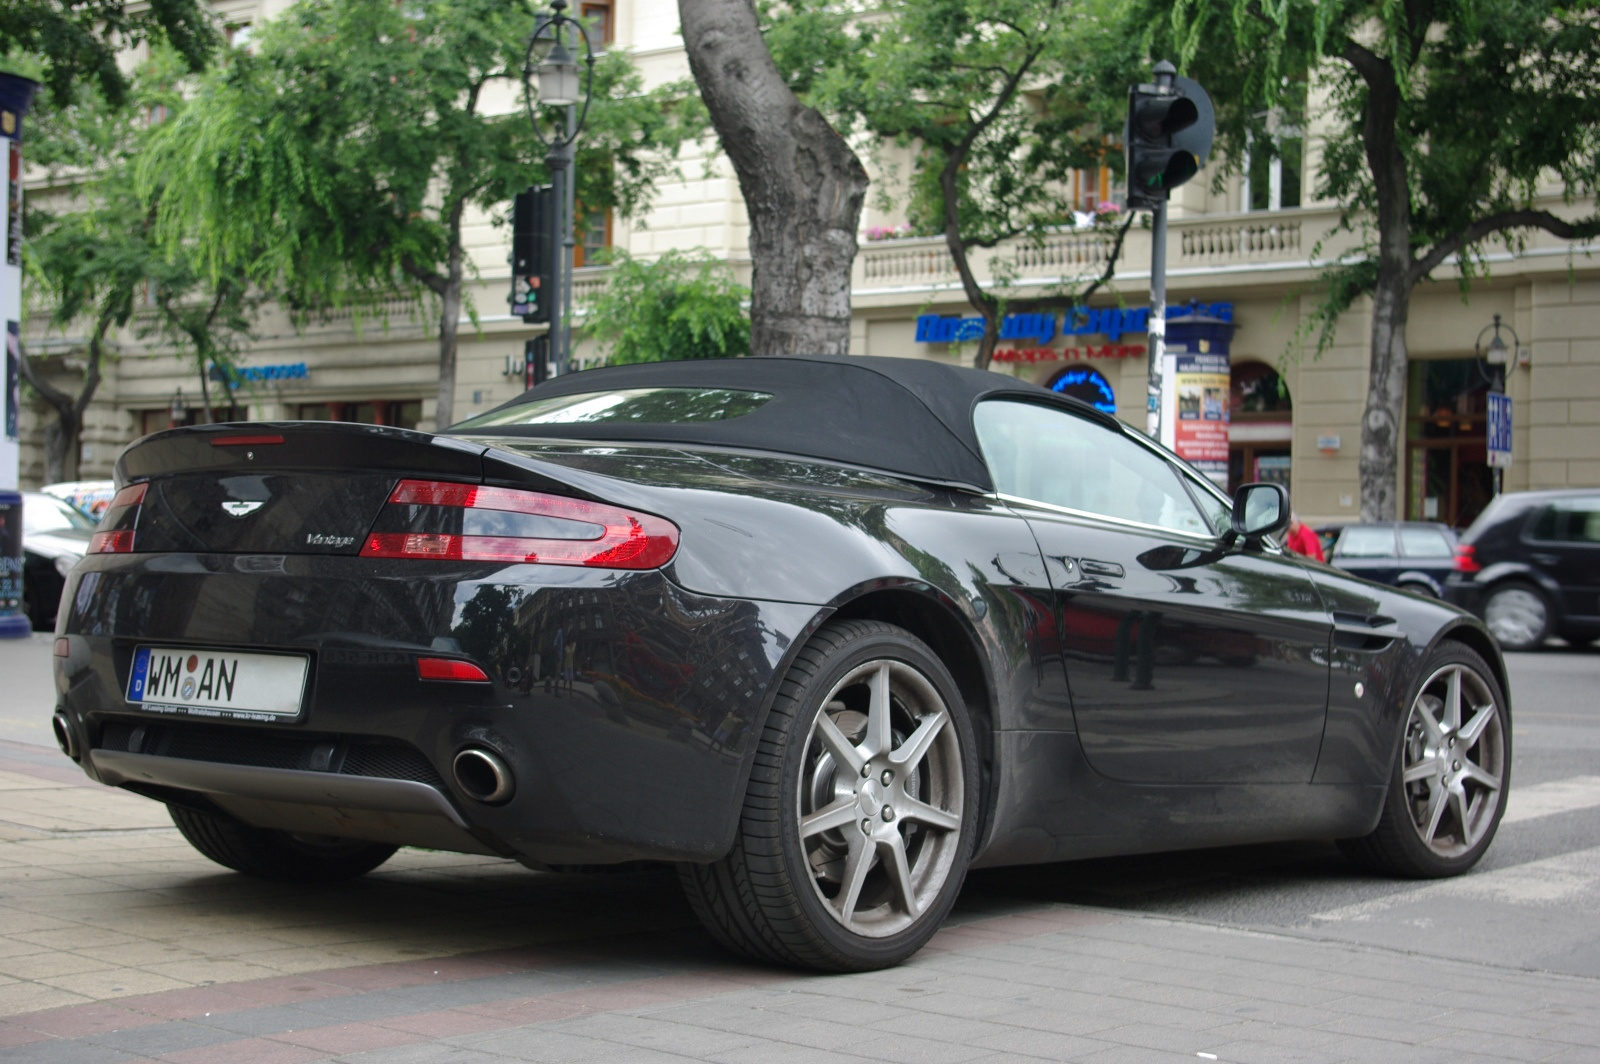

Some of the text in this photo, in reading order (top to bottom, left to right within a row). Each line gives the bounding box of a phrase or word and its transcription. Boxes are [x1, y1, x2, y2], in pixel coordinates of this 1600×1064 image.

[306, 533, 355, 548] Vantage
[134, 679, 143, 692] D
[147, 655, 238, 701] WM AN
